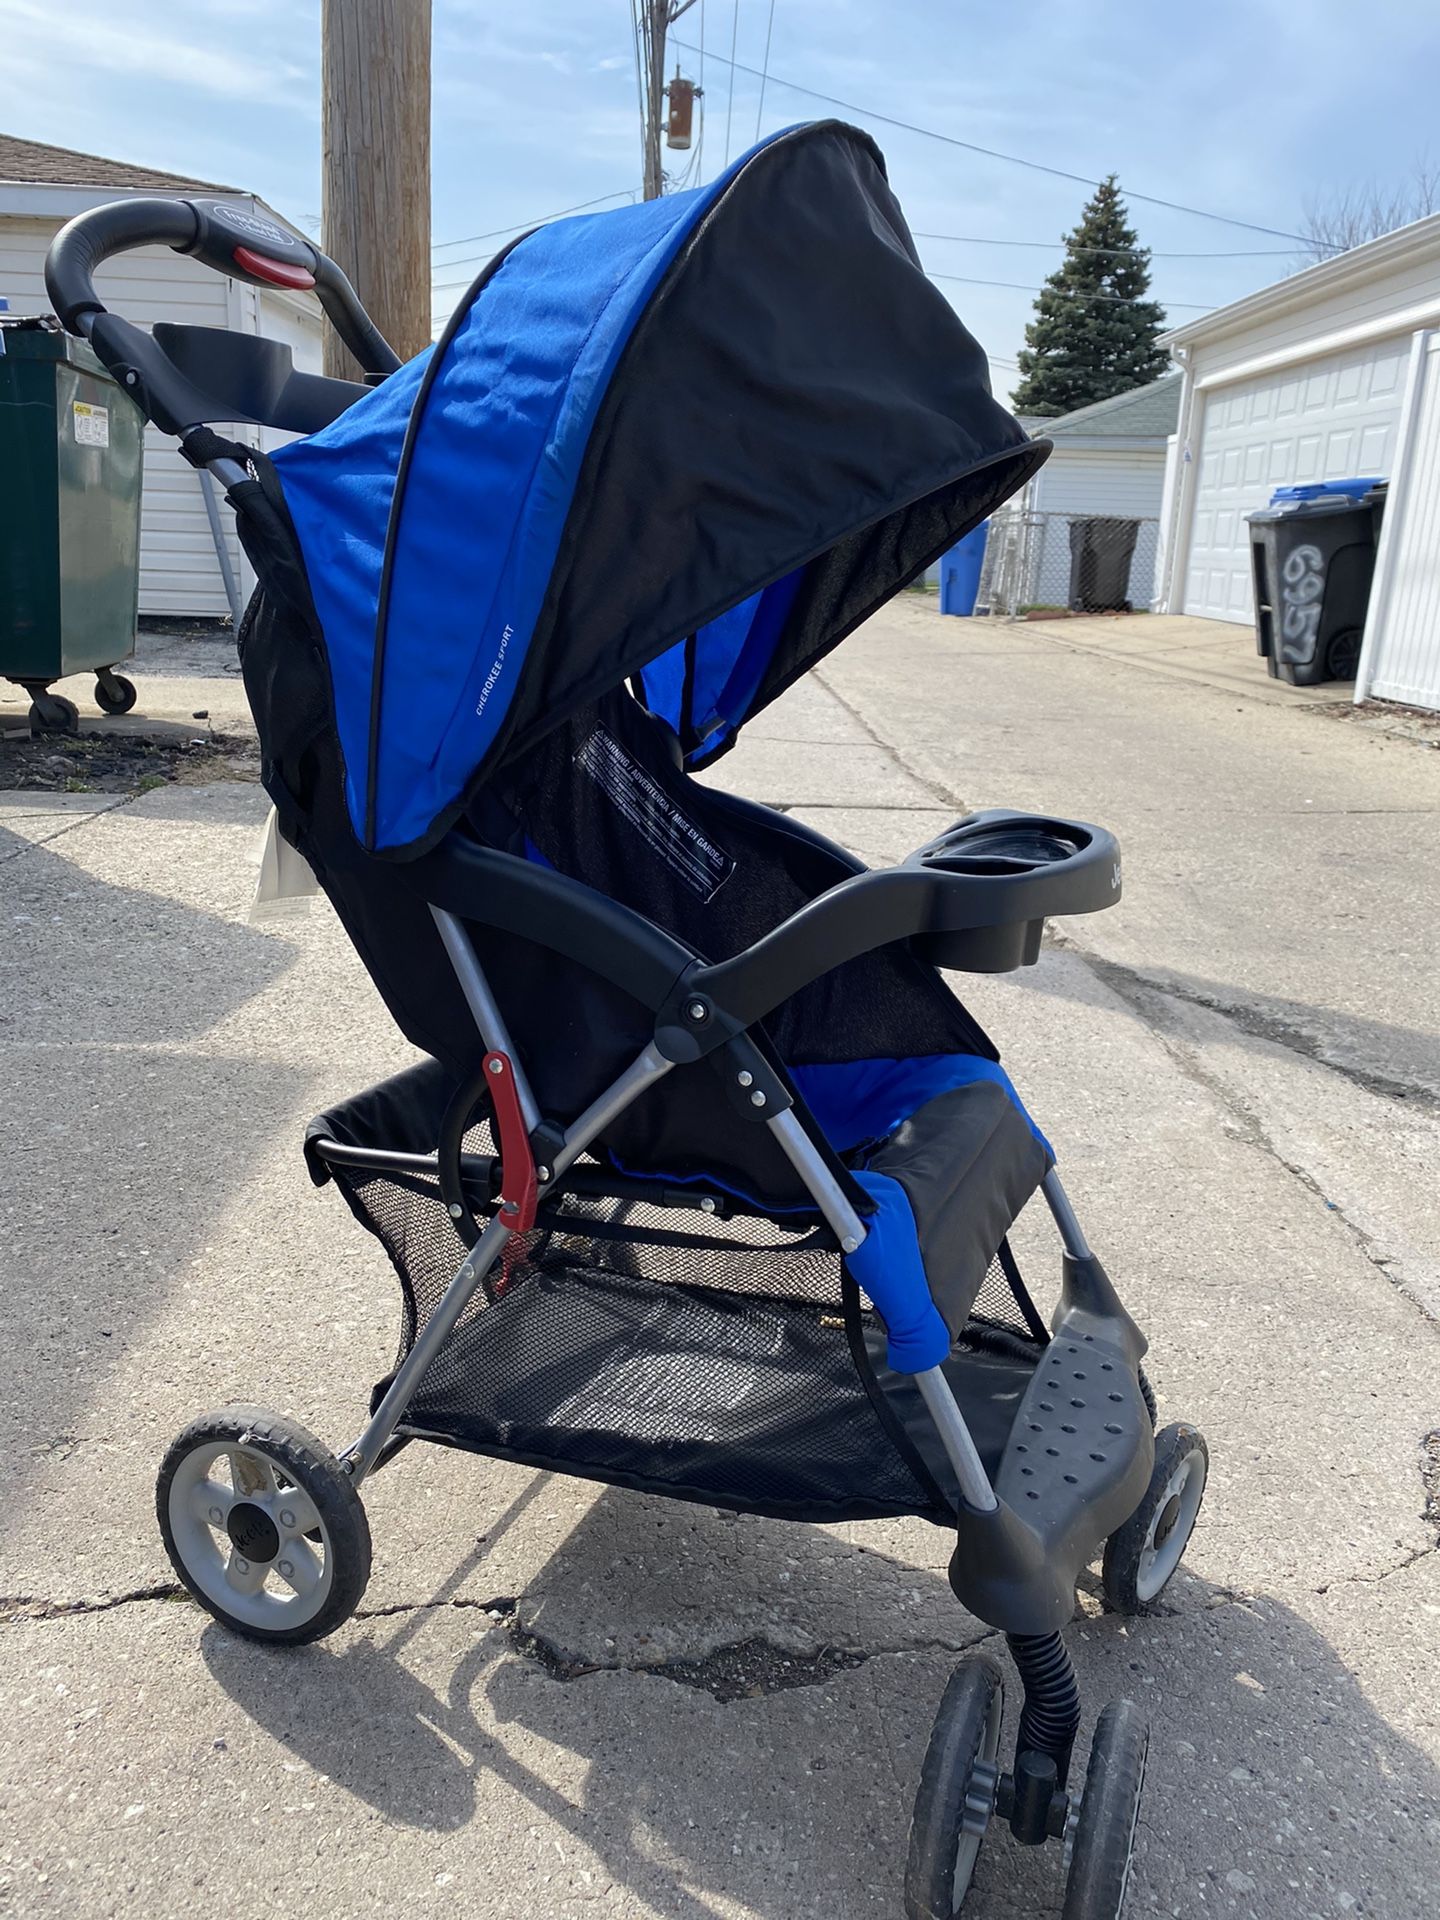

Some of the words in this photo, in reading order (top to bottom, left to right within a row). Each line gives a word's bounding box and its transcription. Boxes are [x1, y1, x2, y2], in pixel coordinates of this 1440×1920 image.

[476, 660, 503, 716] CHEROKEE
[498, 624, 515, 661] SPORT
[603, 736, 630, 767] WARNING
[631, 768, 670, 812] ADVERTENCIA
[672, 813, 689, 832] MISE
[697, 838, 719, 861] GARDE
